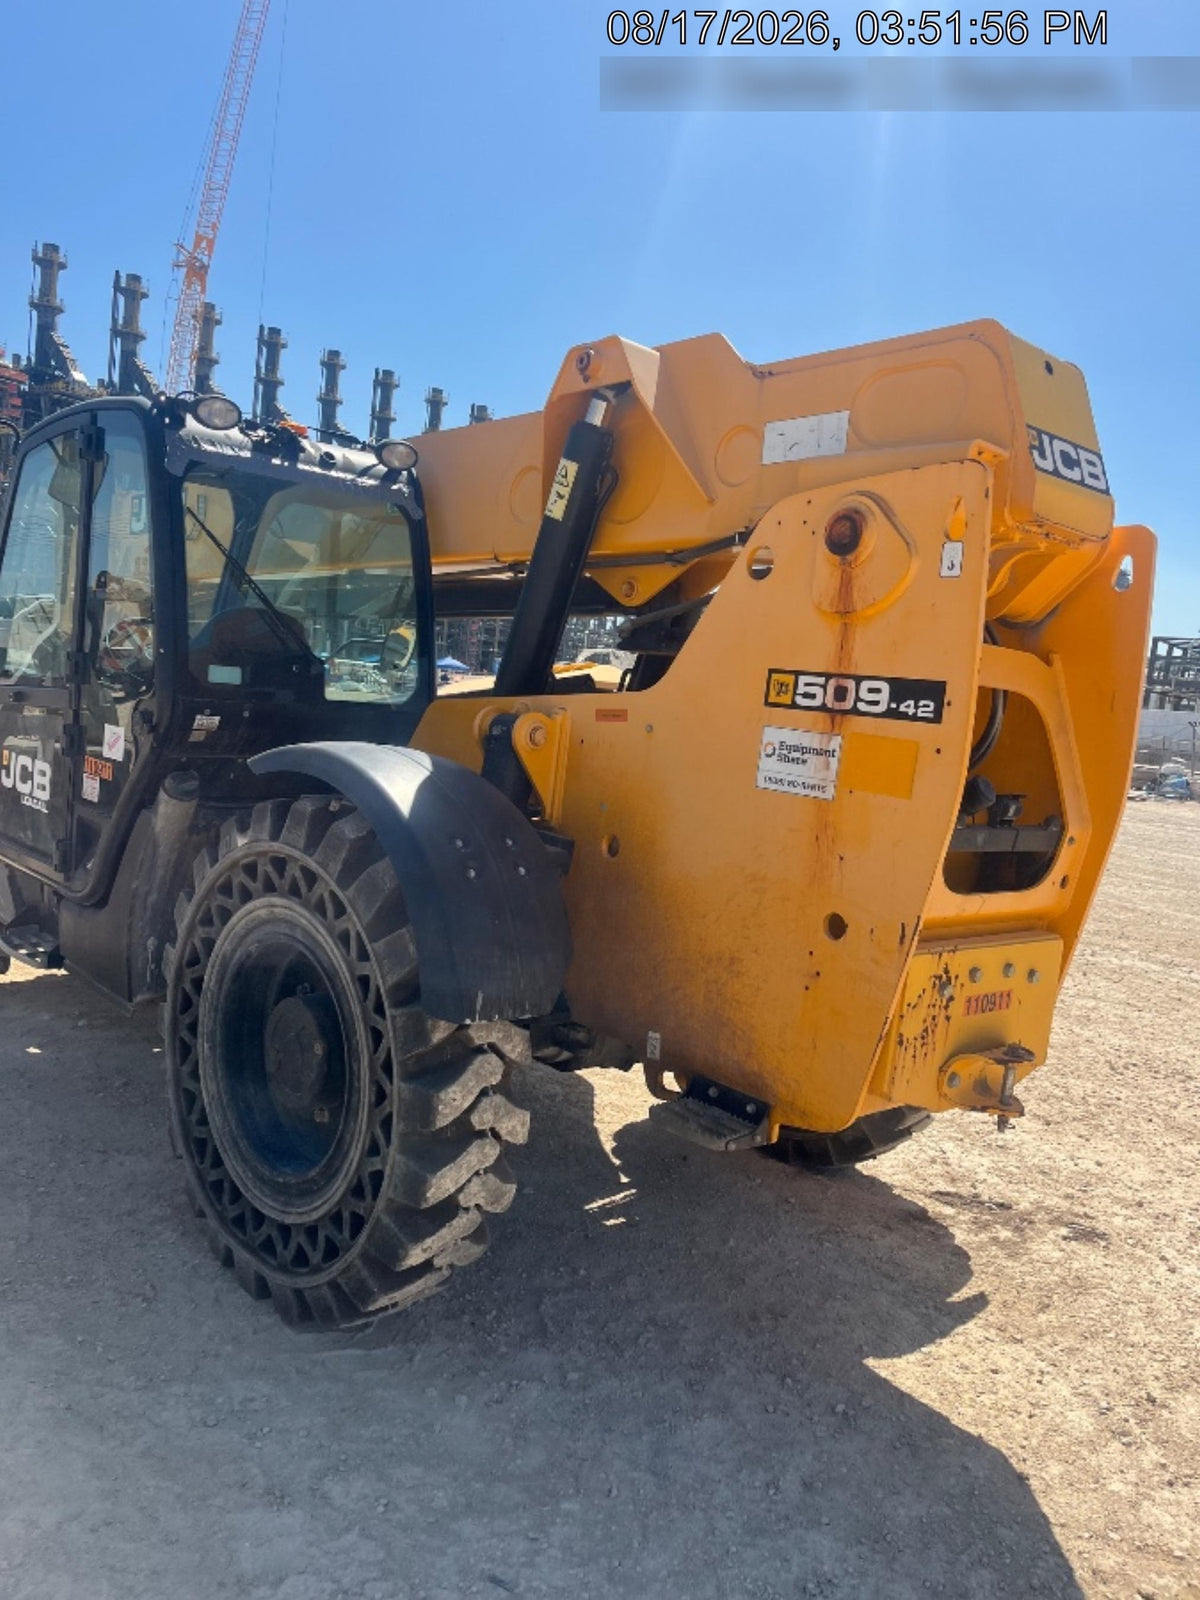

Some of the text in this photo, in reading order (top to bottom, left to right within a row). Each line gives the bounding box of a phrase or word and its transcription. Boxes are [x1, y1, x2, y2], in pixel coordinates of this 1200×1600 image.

[1031, 432, 1107, 491] JCB
[1, 751, 51, 801] JCB
[965, 990, 1012, 1016] 110911
